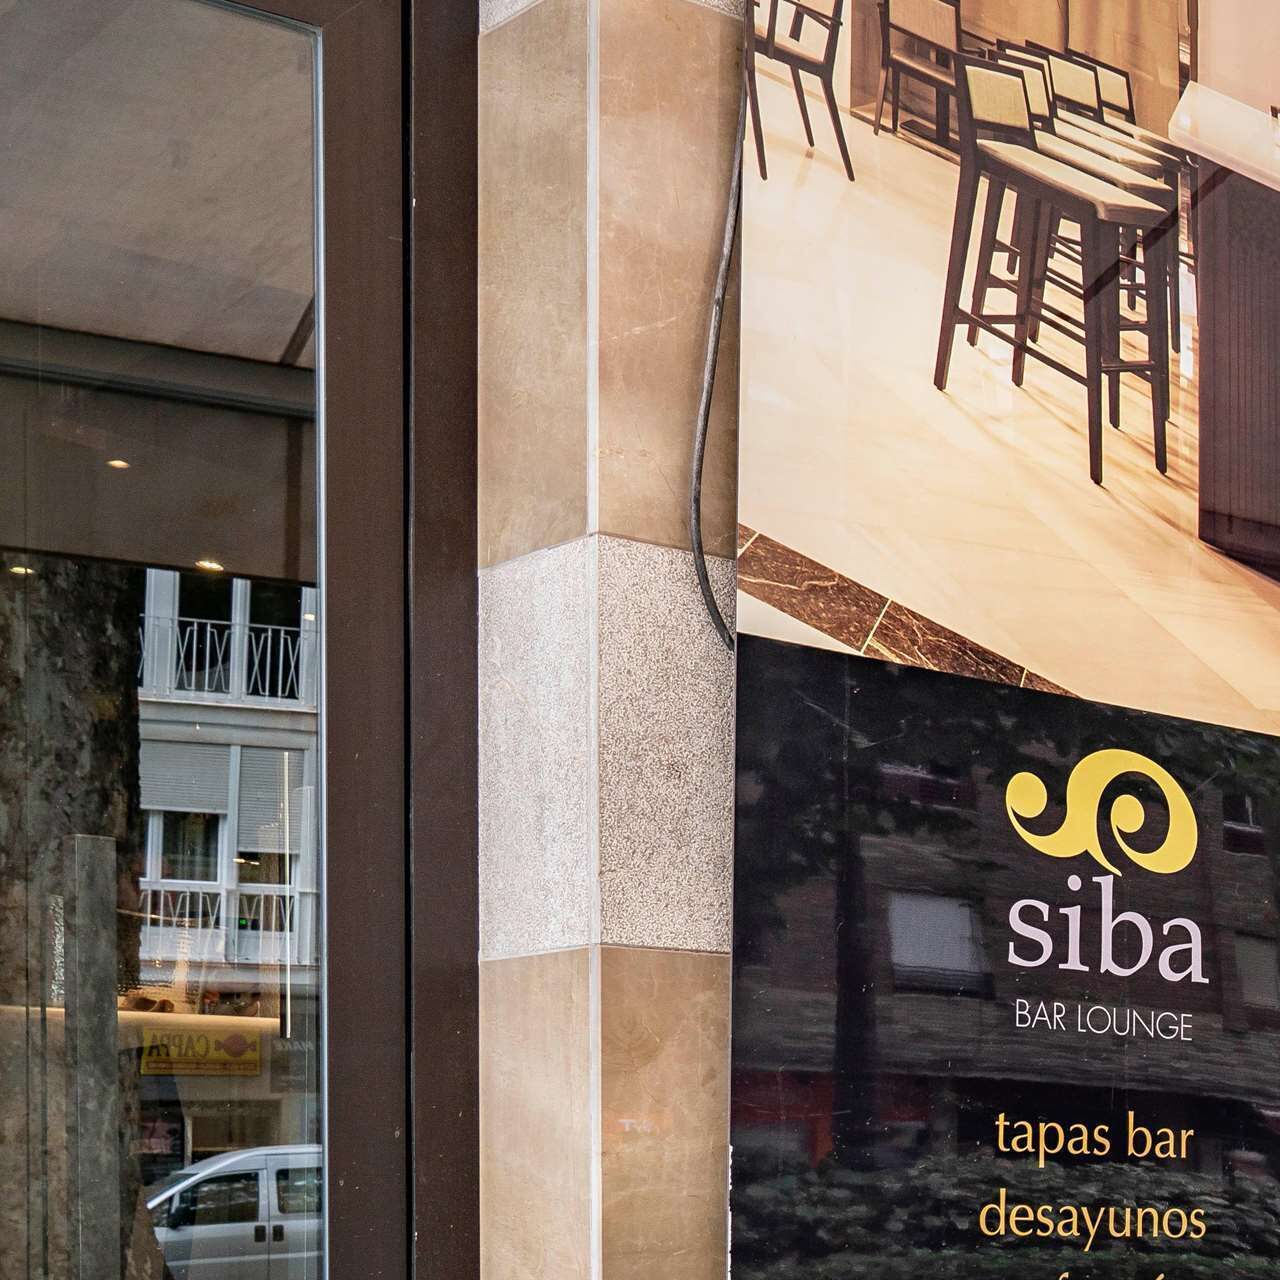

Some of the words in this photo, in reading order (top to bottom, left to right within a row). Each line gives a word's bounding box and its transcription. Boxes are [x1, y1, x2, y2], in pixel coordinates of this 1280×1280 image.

[1008, 874, 1209, 984] siba
[1015, 998, 1066, 1031] BAR
[1077, 1004, 1193, 1041] LOUNGE
[995, 1112, 1110, 1168] tapas
[1127, 1111, 1194, 1159] bar
[979, 1188, 1206, 1251] desayunos
